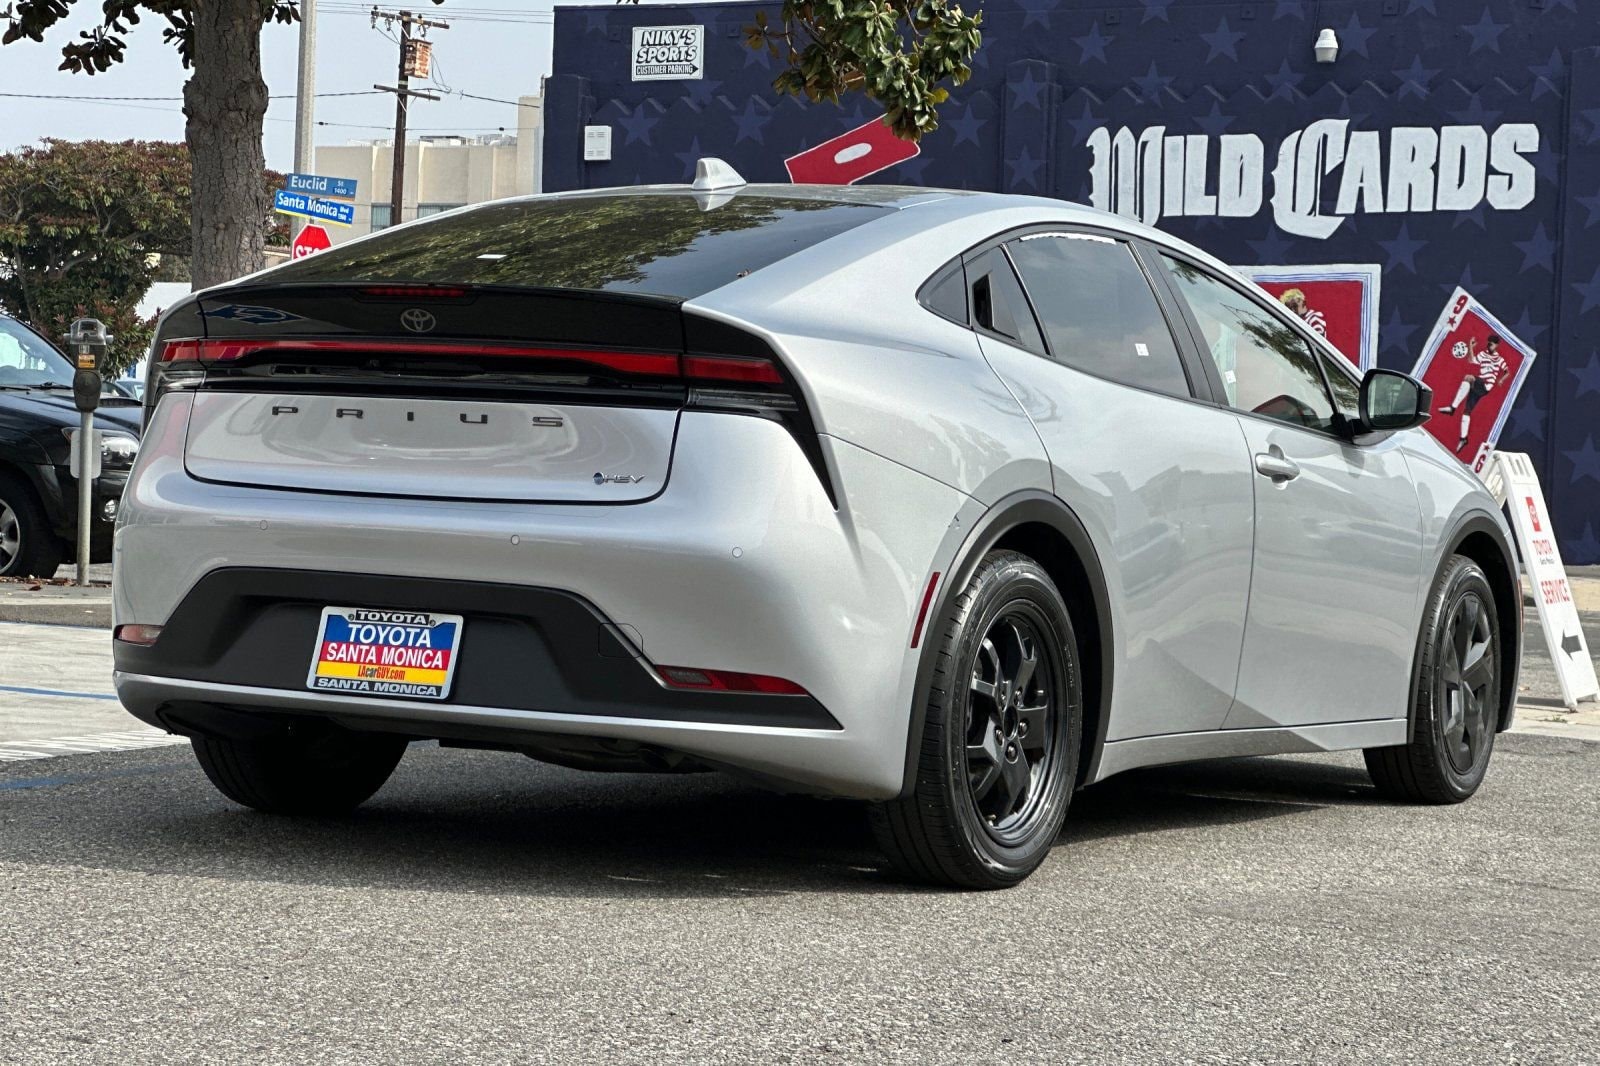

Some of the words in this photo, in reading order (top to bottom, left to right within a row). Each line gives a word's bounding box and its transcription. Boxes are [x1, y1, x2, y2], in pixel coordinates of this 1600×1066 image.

[641, 29, 697, 47] NIKY'S
[636, 46, 697, 64] SPORTS
[636, 65, 667, 75] CUSTOMER
[667, 65, 693, 75] PARKING
[291, 175, 328, 191] Euclid
[1085, 125, 1265, 227] WILD
[1270, 119, 1540, 239] CARDS
[278, 192, 305, 210] Santa
[307, 199, 338, 217] Monica
[1453, 295, 1468, 315] 9
[271, 405, 564, 428] PRIUS
[604, 474, 647, 484] HEV
[358, 611, 427, 625] TOYOTA
[348, 624, 432, 648] TOYOTA
[326, 642, 377, 664] SANTA
[381, 647, 443, 669] MONICA
[357, 665, 406, 681] LAcarGUY.com
[318, 678, 370, 691] SANTA
[373, 681, 437, 696] MONICA
